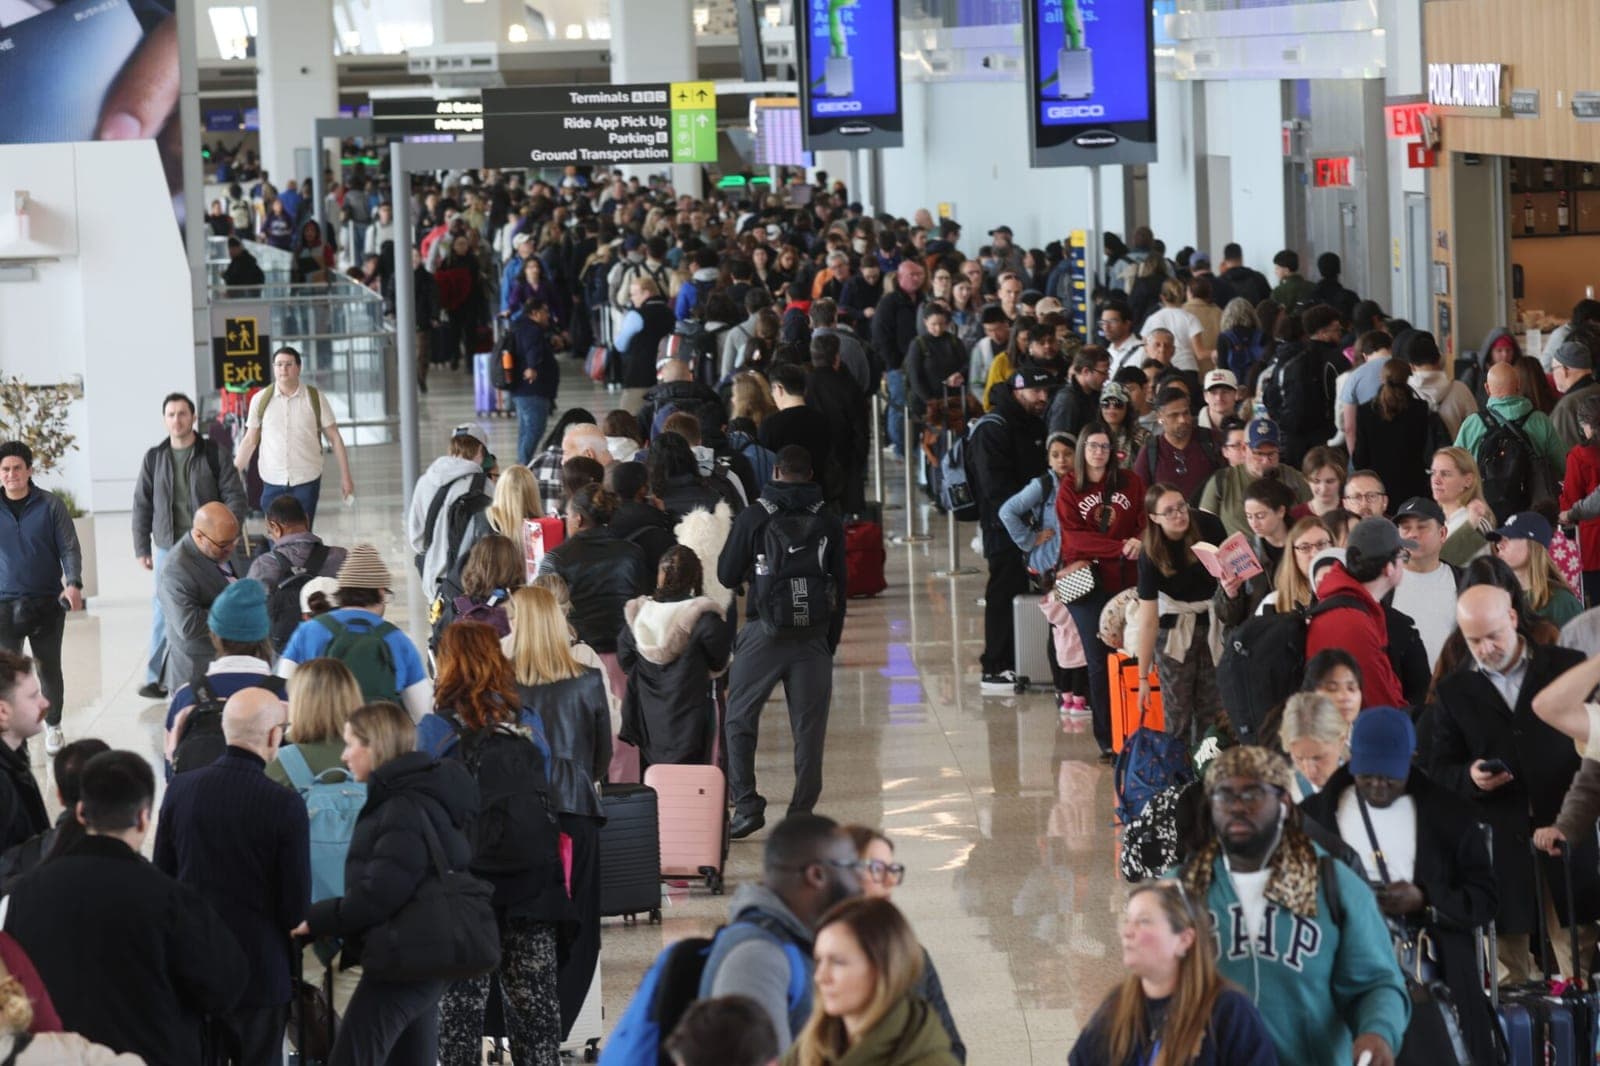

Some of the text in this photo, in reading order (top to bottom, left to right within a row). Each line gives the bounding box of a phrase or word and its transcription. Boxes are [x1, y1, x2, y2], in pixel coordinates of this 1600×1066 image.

[1428, 63, 1501, 106] POUR AUTHORITY
[568, 91, 629, 104] Terminals
[816, 101, 862, 113] GEICO
[1047, 104, 1104, 118] GEICO
[563, 115, 667, 130] Ride App Pick Up
[608, 132, 655, 146] Parking
[530, 147, 669, 162] Ground Transportation
[1316, 157, 1350, 188] EXIT
[223, 361, 263, 382] Exit
